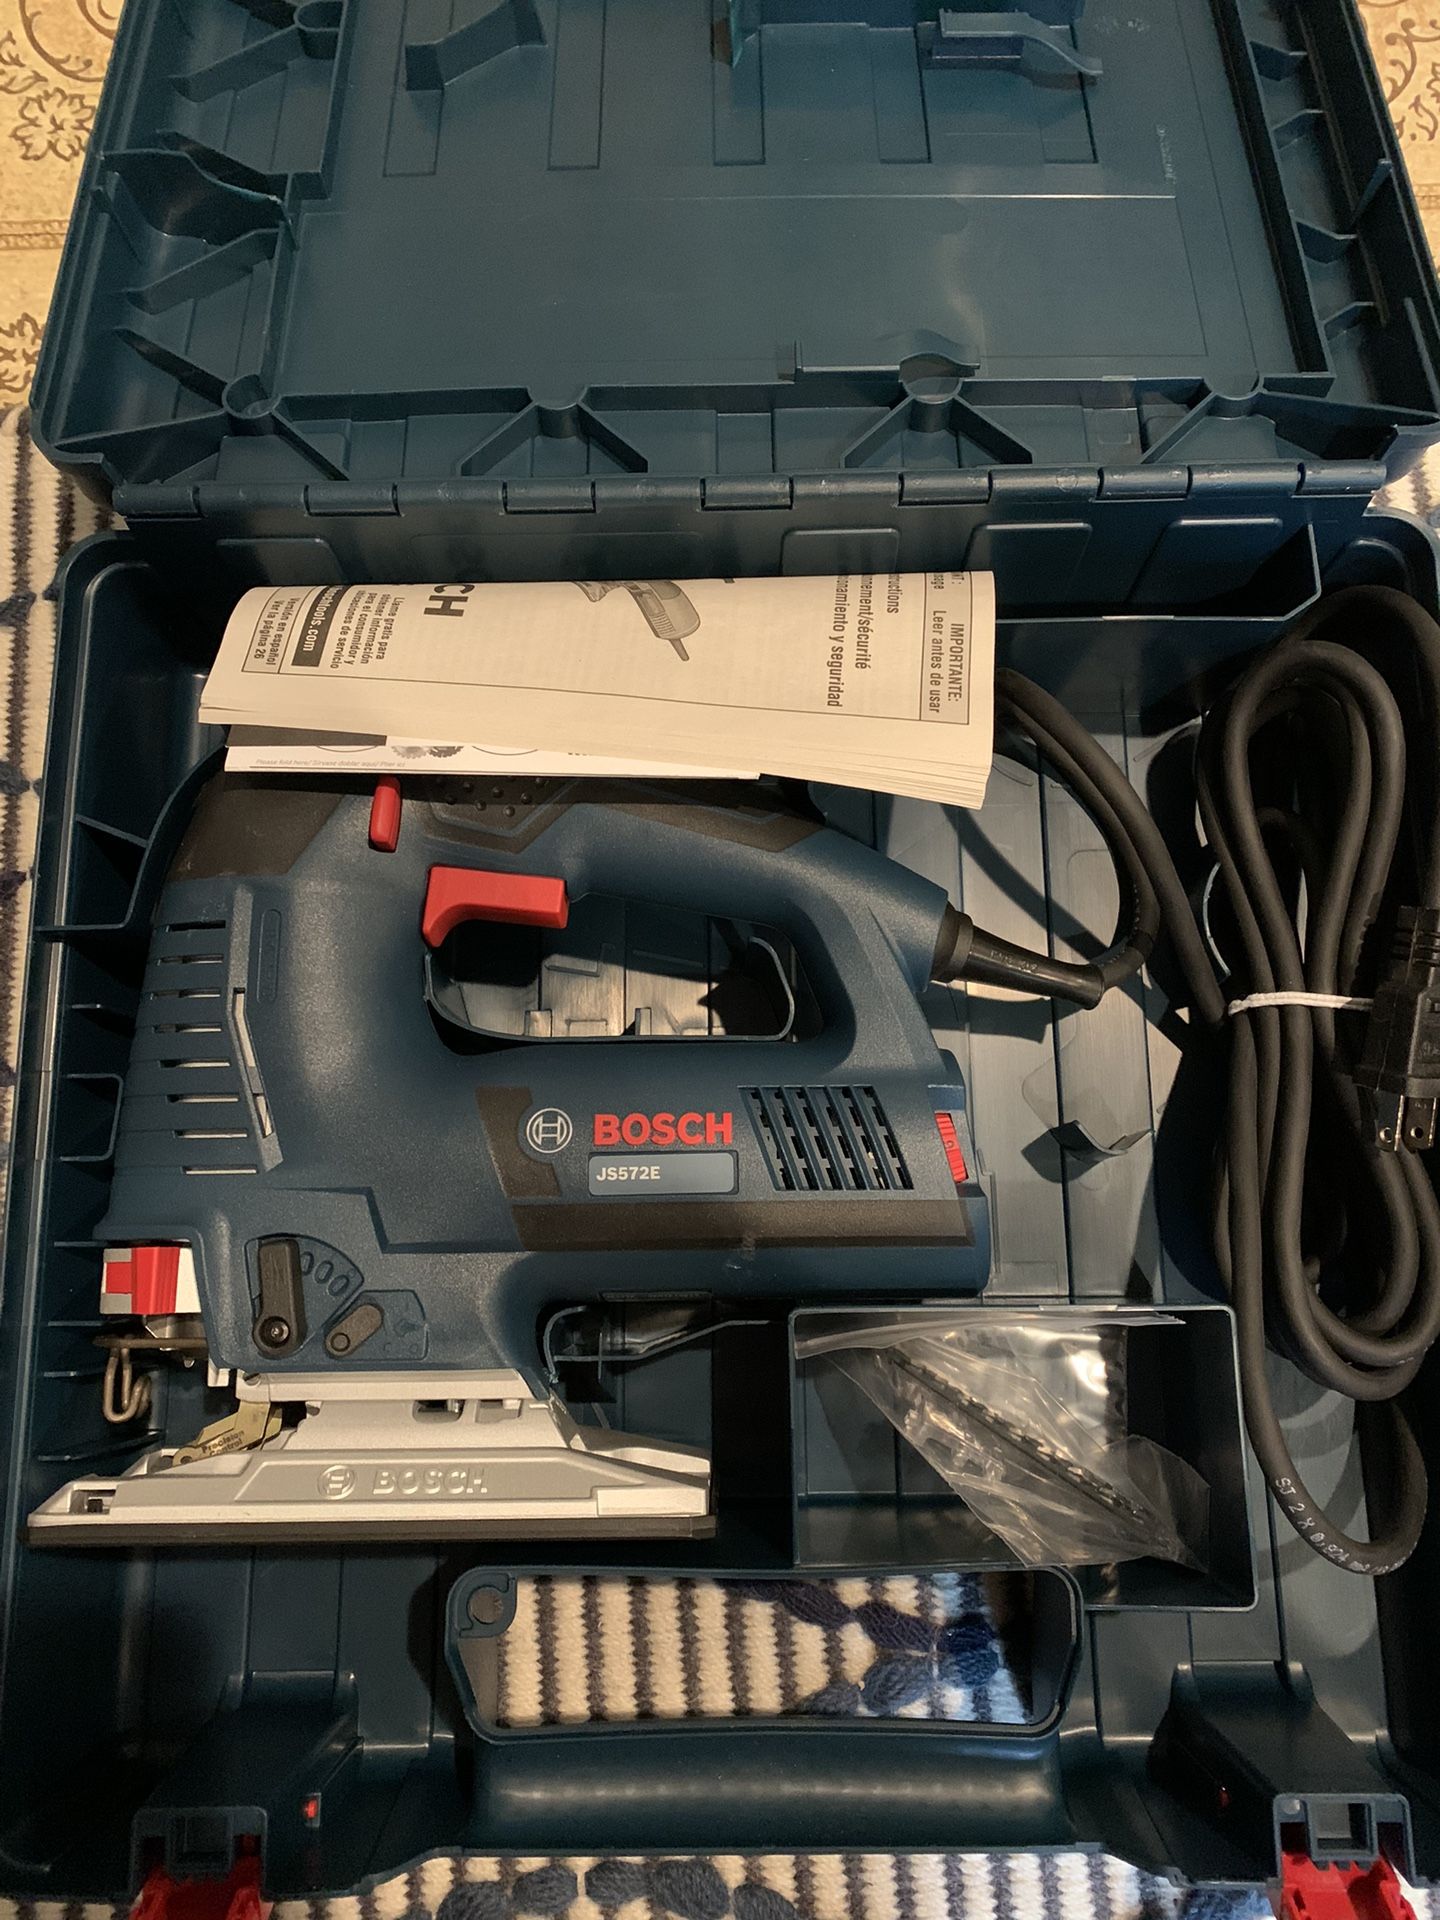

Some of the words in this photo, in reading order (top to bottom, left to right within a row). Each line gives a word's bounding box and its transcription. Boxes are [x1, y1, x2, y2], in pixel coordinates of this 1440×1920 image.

[271, 600, 284, 612] Ver
[284, 597, 300, 621] Versión
[362, 605, 373, 613] el
[364, 592, 377, 606] para
[374, 594, 391, 617] obtener
[388, 597, 405, 617] Llame
[266, 611, 276, 619] la
[276, 621, 287, 632] en
[932, 610, 947, 634] Leer
[258, 620, 273, 647] página
[339, 625, 352, 636] de
[349, 613, 368, 654] consumidor
[382, 617, 395, 640] gratis
[828, 635, 844, 643] y
[265, 633, 283, 666] español
[360, 617, 383, 665] información
[376, 641, 388, 660] para
[253, 648, 266, 659] 26
[330, 637, 347, 669] servicio
[930, 638, 944, 669] antes
[947, 623, 965, 702] IMPORTANTE:
[826, 645, 845, 707] seguridad
[929, 672, 944, 686] de
[928, 689, 940, 713] usar
[593, 1111, 733, 1146] BOSCH
[596, 1165, 661, 1181] JS572E
[201, 1430, 245, 1454] Precision
[372, 1468, 488, 1495] BOSCH
[1288, 1502, 1306, 1514] 2
